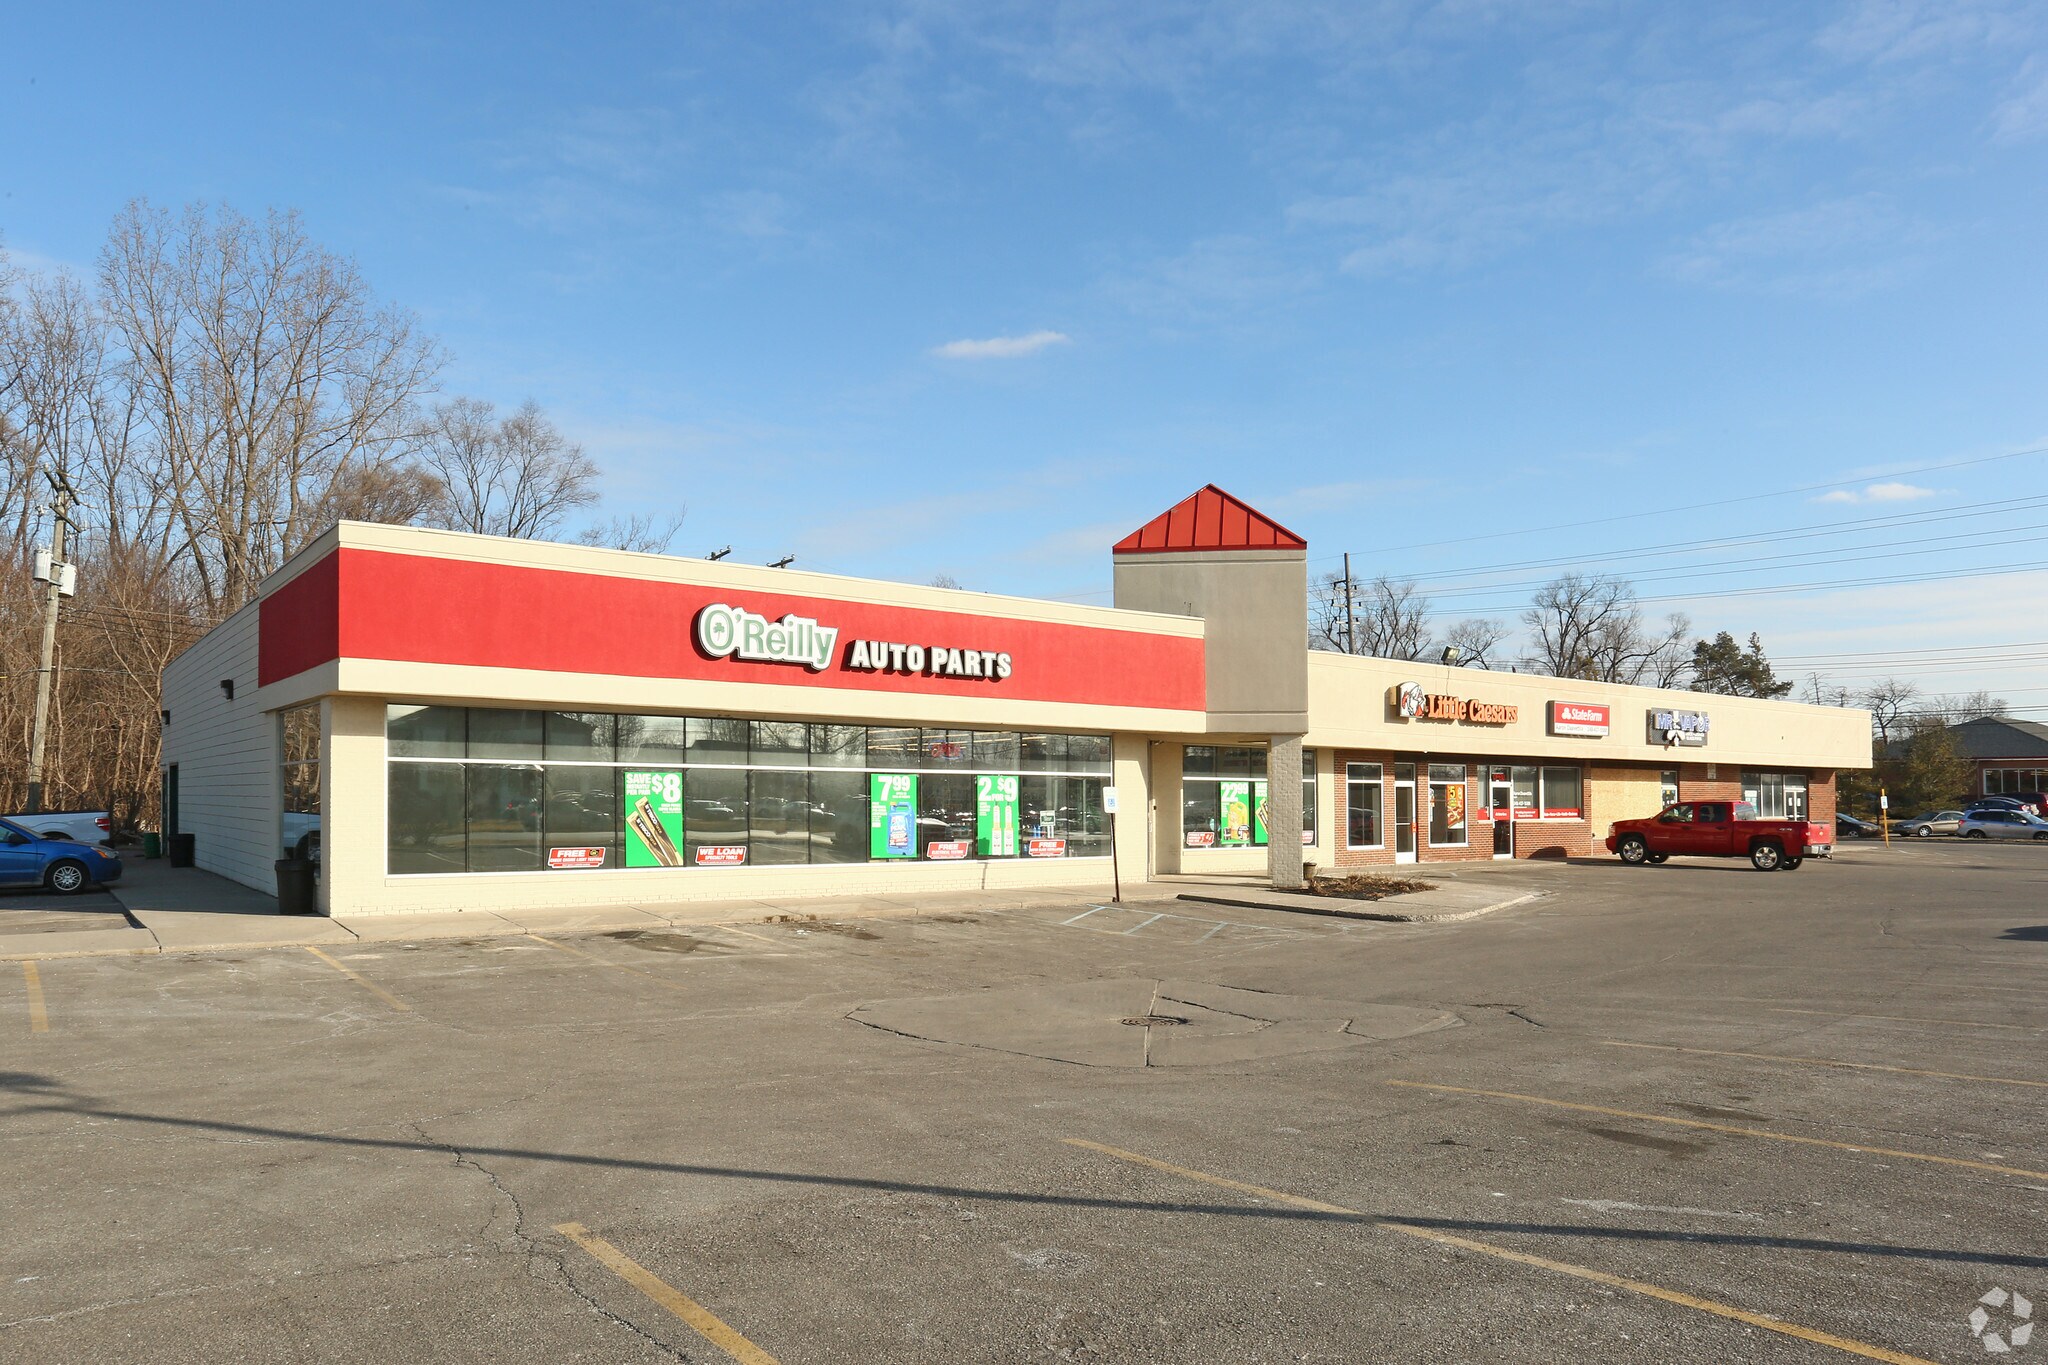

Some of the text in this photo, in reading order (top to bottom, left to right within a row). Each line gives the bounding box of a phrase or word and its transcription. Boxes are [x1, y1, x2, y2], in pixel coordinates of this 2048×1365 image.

[701, 606, 1013, 678] O'Reilly AUTO PARTS
[1428, 694, 1518, 724] Little Caesars
[1656, 713, 1673, 731] MR
[626, 773, 681, 803] SAVE $8
[557, 849, 586, 857] FREE
